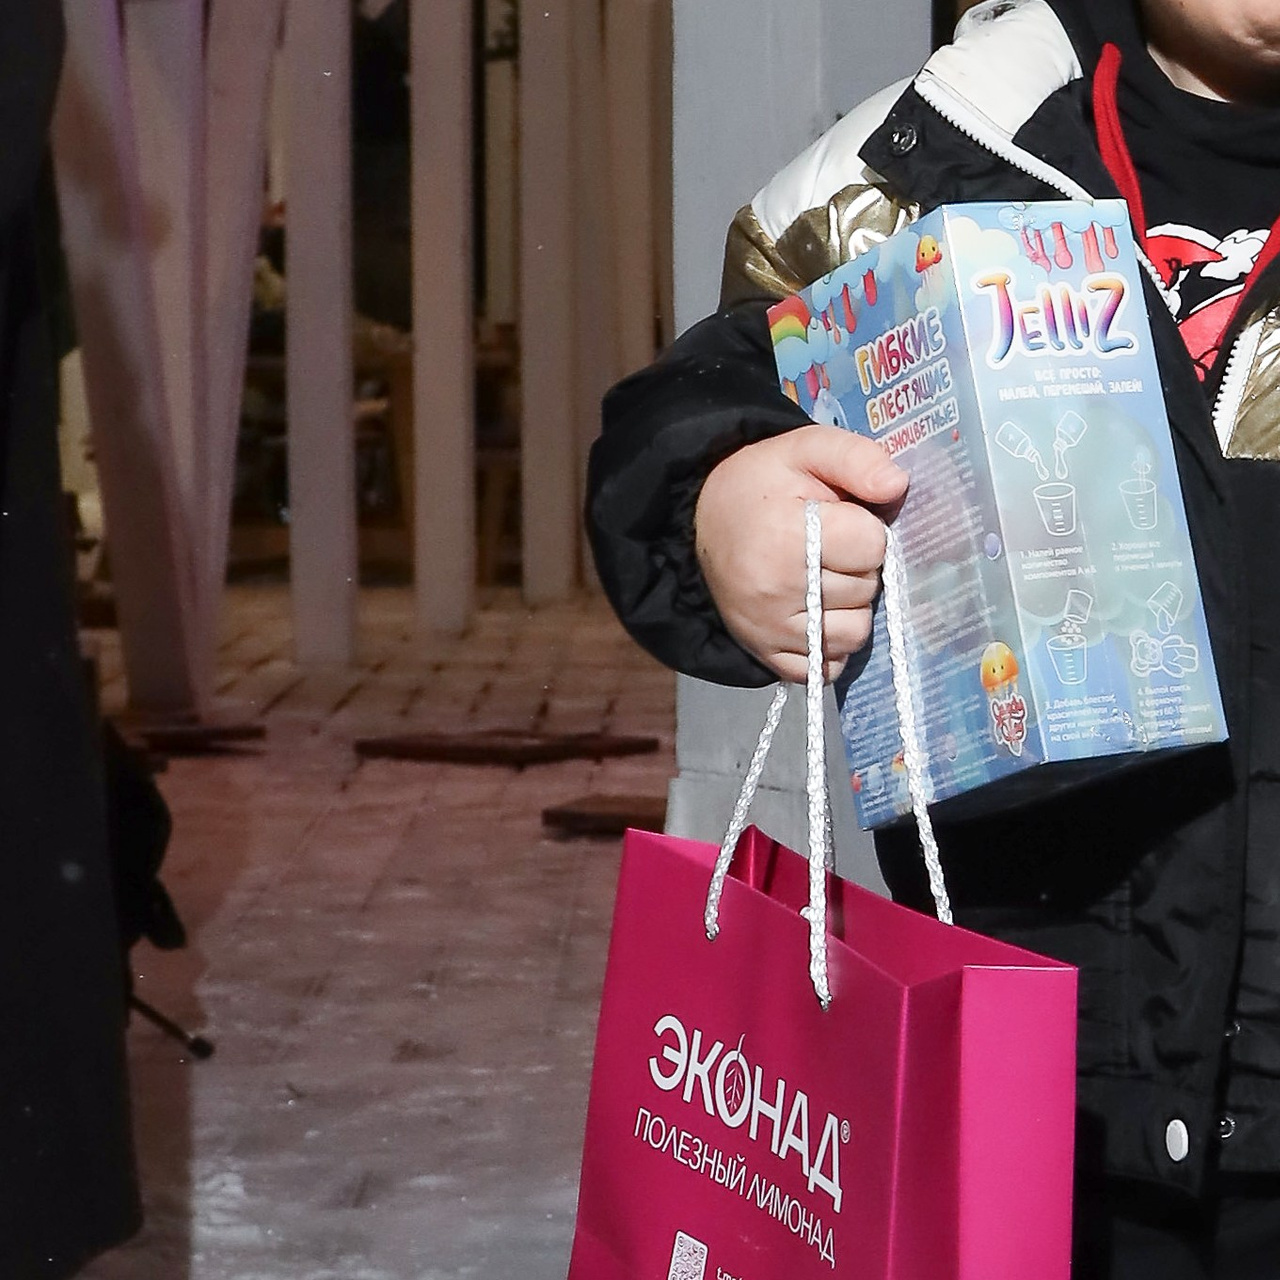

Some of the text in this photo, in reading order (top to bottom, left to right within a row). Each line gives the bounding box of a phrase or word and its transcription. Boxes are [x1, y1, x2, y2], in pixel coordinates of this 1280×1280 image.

[856, 310, 945, 393] ГИБКИЕ
[998, 378, 1144, 401] НАЛЕЙ, ПЕРЕМЕШАЙ, ЗАЛЕЙ!
[868, 360, 951, 430] БЛЕСТЯЩИЕ
[878, 400, 958, 457] АЗНОЦВЕТНЫЕ!
[649, 1014, 843, 1213] ЭКОНАД
[634, 1107, 836, 1269] ПОЛЕЗНЫЙ ЛИМОНАД
